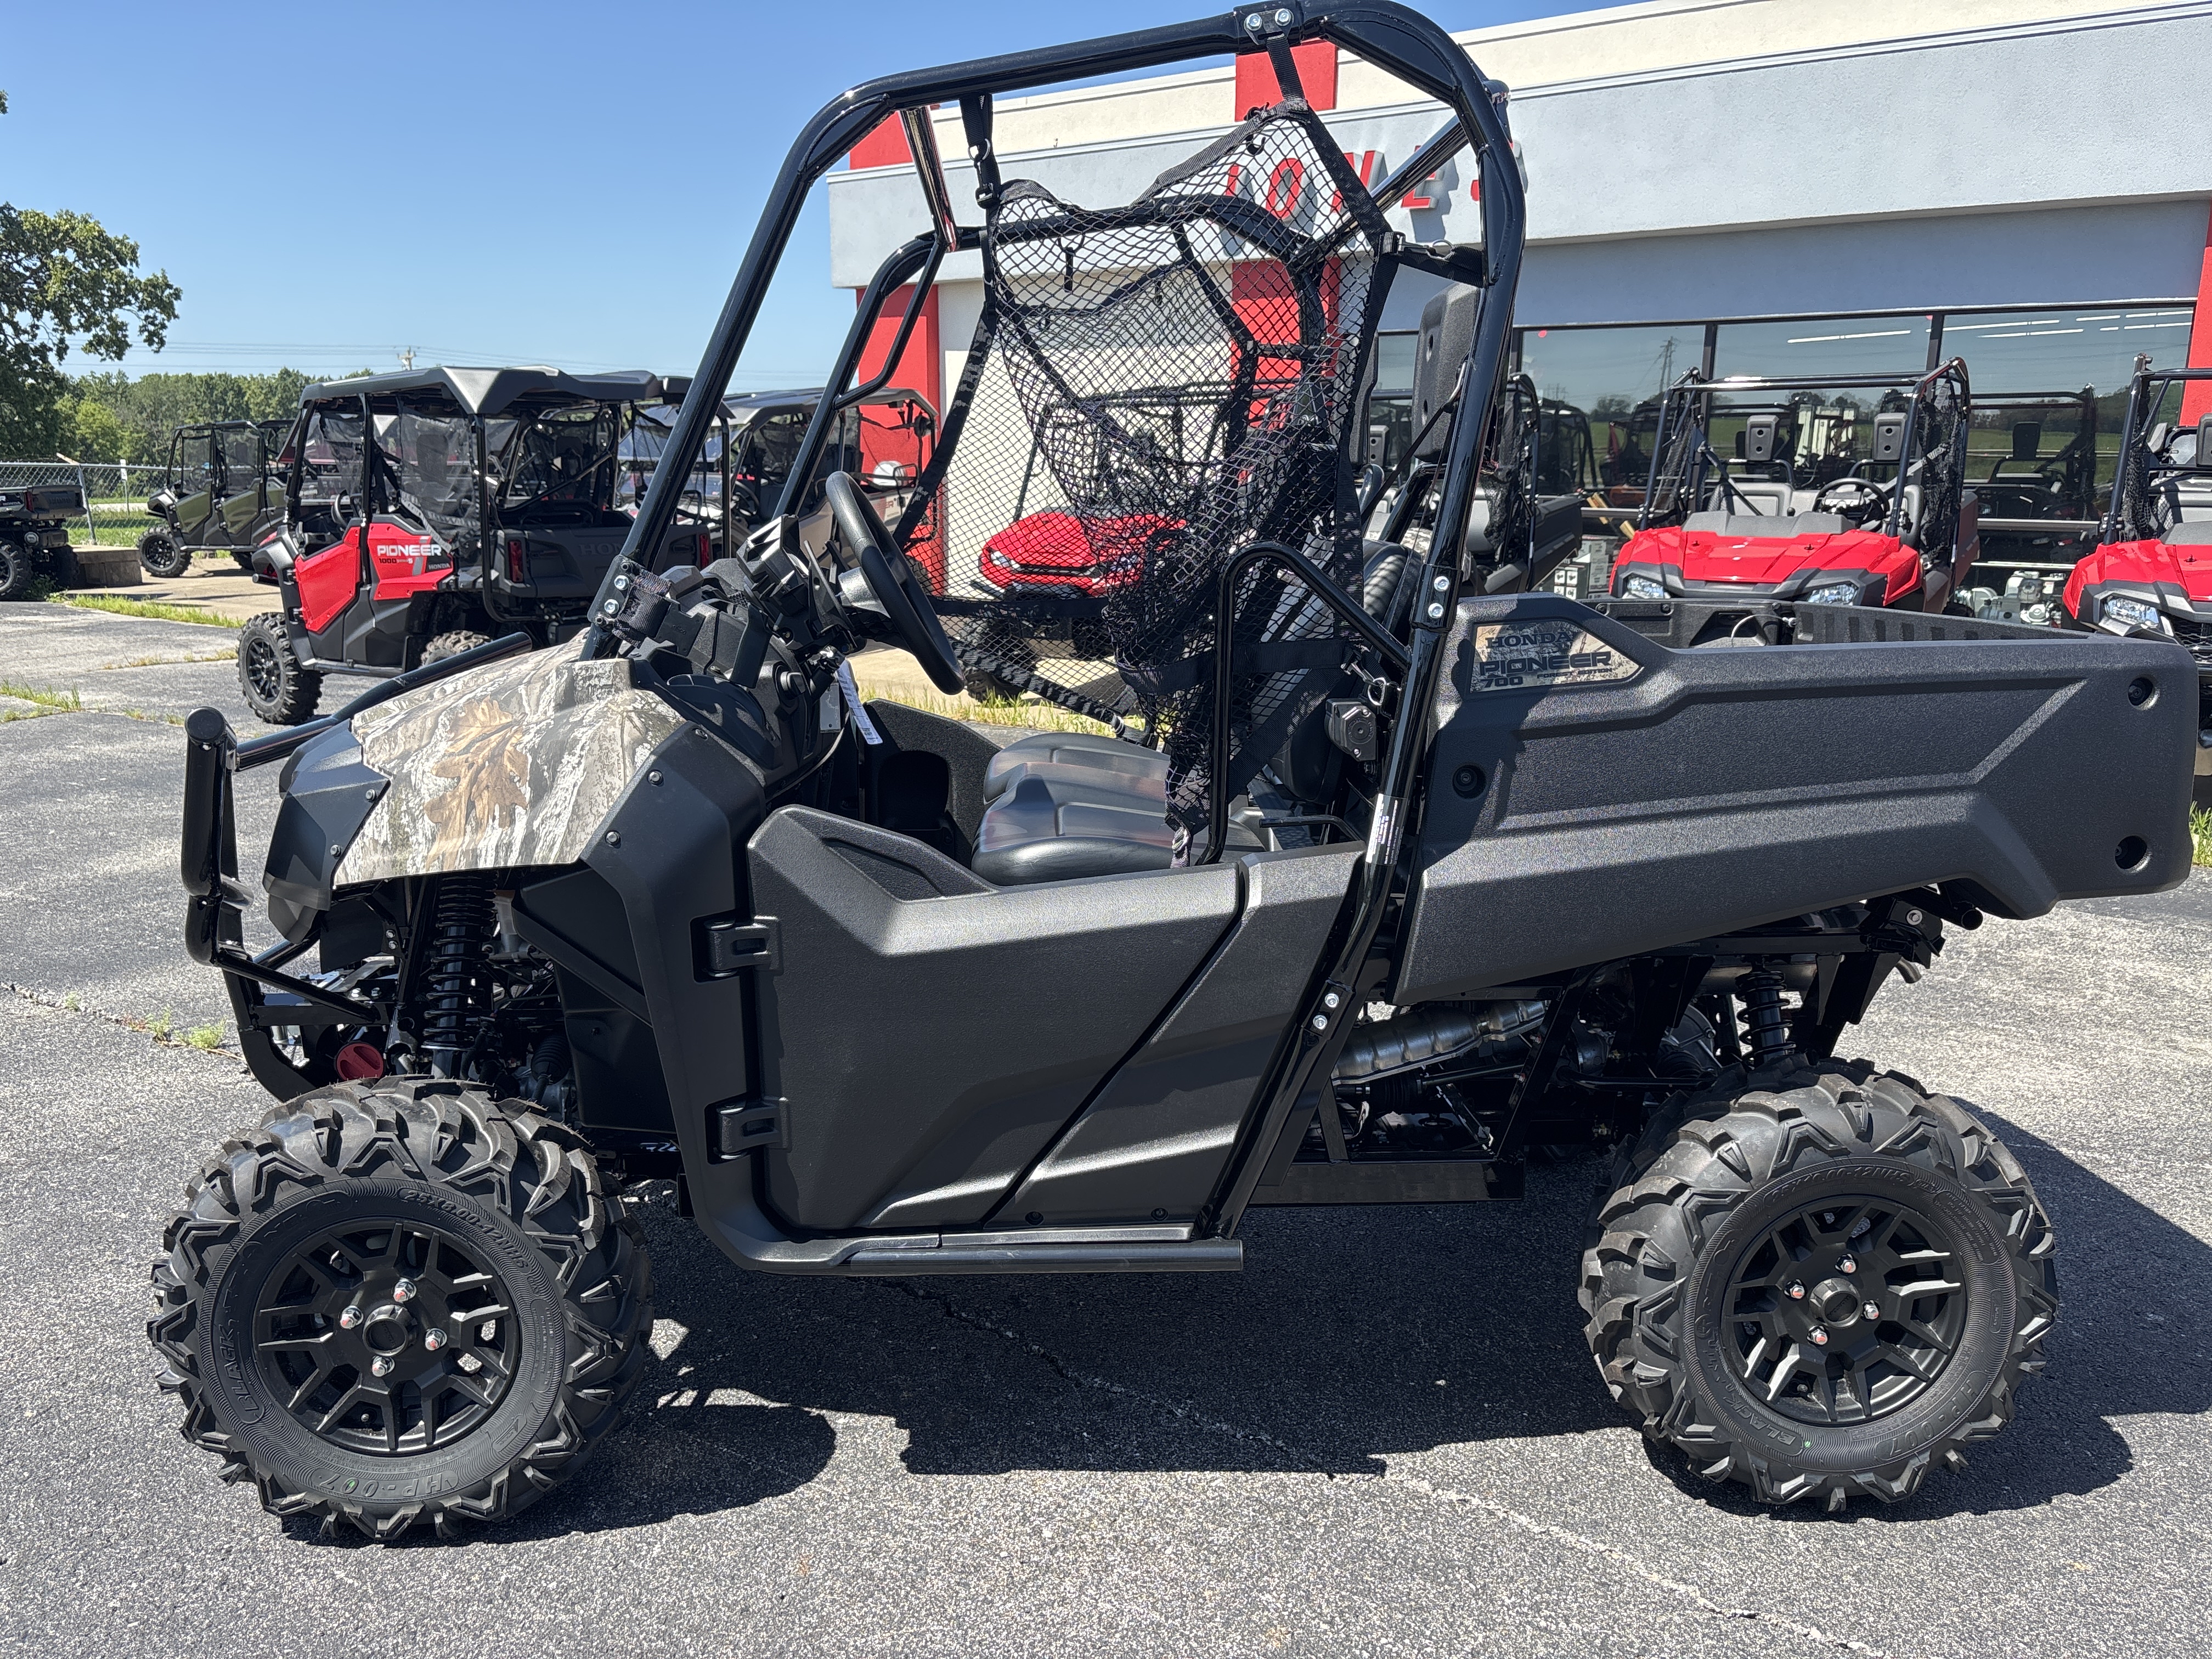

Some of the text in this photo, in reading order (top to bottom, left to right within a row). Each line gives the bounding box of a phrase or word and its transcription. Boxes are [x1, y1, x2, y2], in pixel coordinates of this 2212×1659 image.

[377, 544, 442, 556] PIONEER
[1485, 631, 1573, 650] HONDA
[1479, 651, 1611, 676] PIONEER
[1480, 676, 1523, 688] 700
[1537, 671, 1575, 679] FOREST
[218, 1324, 258, 1414] BLACK
[1723, 1391, 1796, 1446] BLACK
[318, 1471, 449, 1497] HP-007
